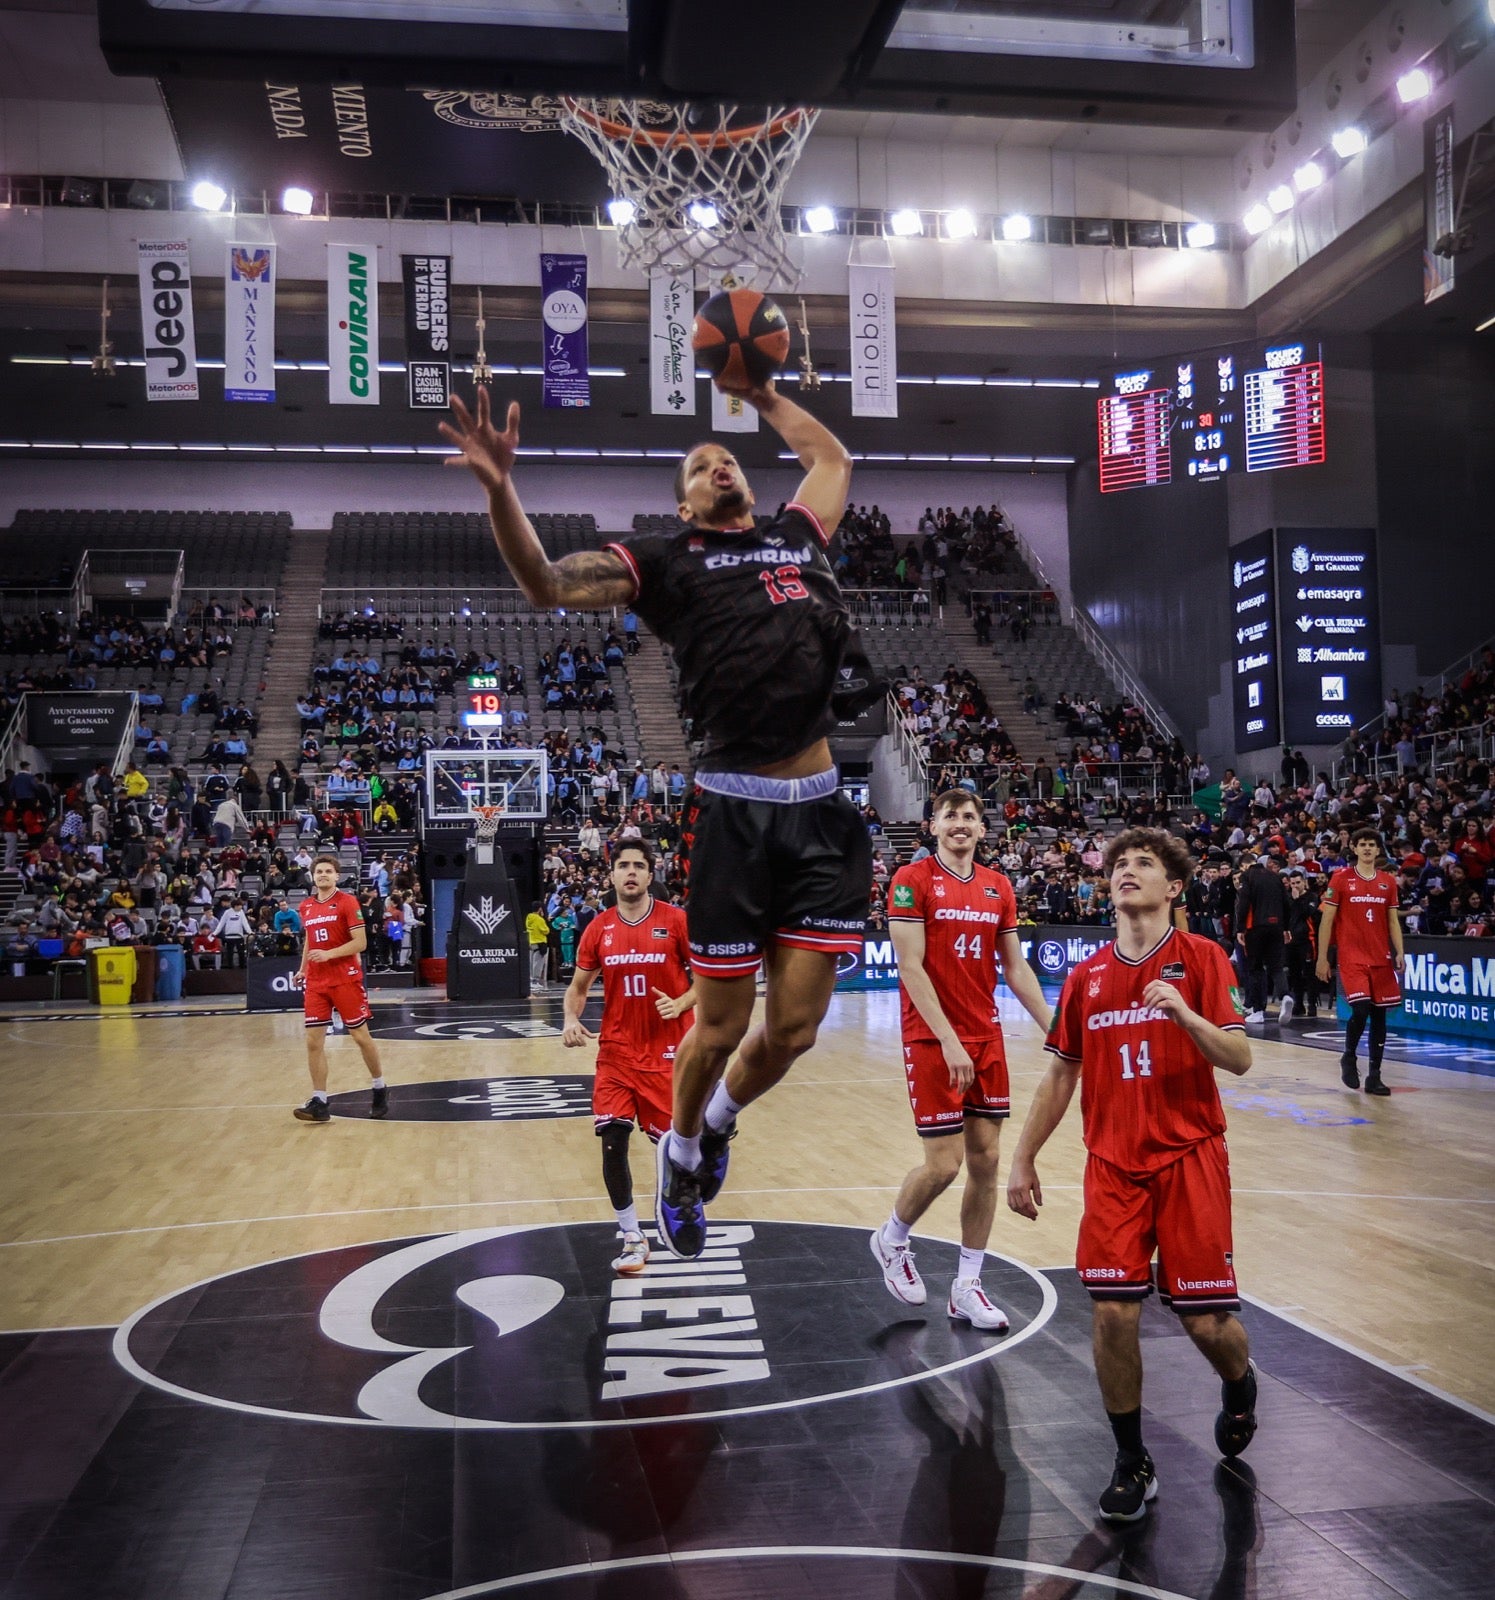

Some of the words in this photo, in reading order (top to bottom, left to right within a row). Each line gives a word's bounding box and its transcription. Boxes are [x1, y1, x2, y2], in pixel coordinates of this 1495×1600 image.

[139, 242, 187, 252] MotorDOS
[415, 258, 428, 272] DE
[415, 275, 430, 331] VERDAD
[429, 258, 448, 351] BURGERS
[551, 302, 578, 314] OYA
[146, 261, 189, 378] Jeep
[244, 287, 257, 384] MANZANO
[855, 293, 879, 390] niobio
[415, 367, 443, 377] SAN-
[149, 383, 197, 393] MotorDOS
[415, 377, 444, 387] CASUAL
[1220, 378, 1233, 392] 51
[416, 393, 444, 403] -CHO
[1178, 384, 1192, 399] 30
[1194, 432, 1221, 452] 8:13
[1188, 462, 1197, 476] 0
[1219, 457, 1228, 472] 0
[758, 564, 809, 605] 19
[1307, 588, 1361, 601] emasagra
[1314, 618, 1334, 627] CAJA
[1336, 618, 1366, 627] RURAL
[1313, 648, 1365, 662] Alhambra
[473, 677, 498, 688] 8:13
[1323, 688, 1340, 698] AXA
[48, 706, 115, 715] AYUNTAMIENTO
[471, 694, 499, 714] 19
[1365, 908, 1374, 922] 4
[315, 928, 329, 942] 19
[459, 949, 483, 957] CAJA
[484, 948, 519, 957] RURAL
[708, 942, 746, 955] asisa
[954, 933, 982, 959] 44
[1404, 953, 1467, 994] Mica
[623, 974, 647, 997] 10
[1405, 998, 1418, 1014] EL
[1422, 1000, 1466, 1019] MOTOR
[1471, 1005, 1488, 1021] DE
[1119, 1040, 1152, 1080] 14
[1085, 1268, 1117, 1278] asisa
[1187, 1280, 1235, 1290] BERNER
